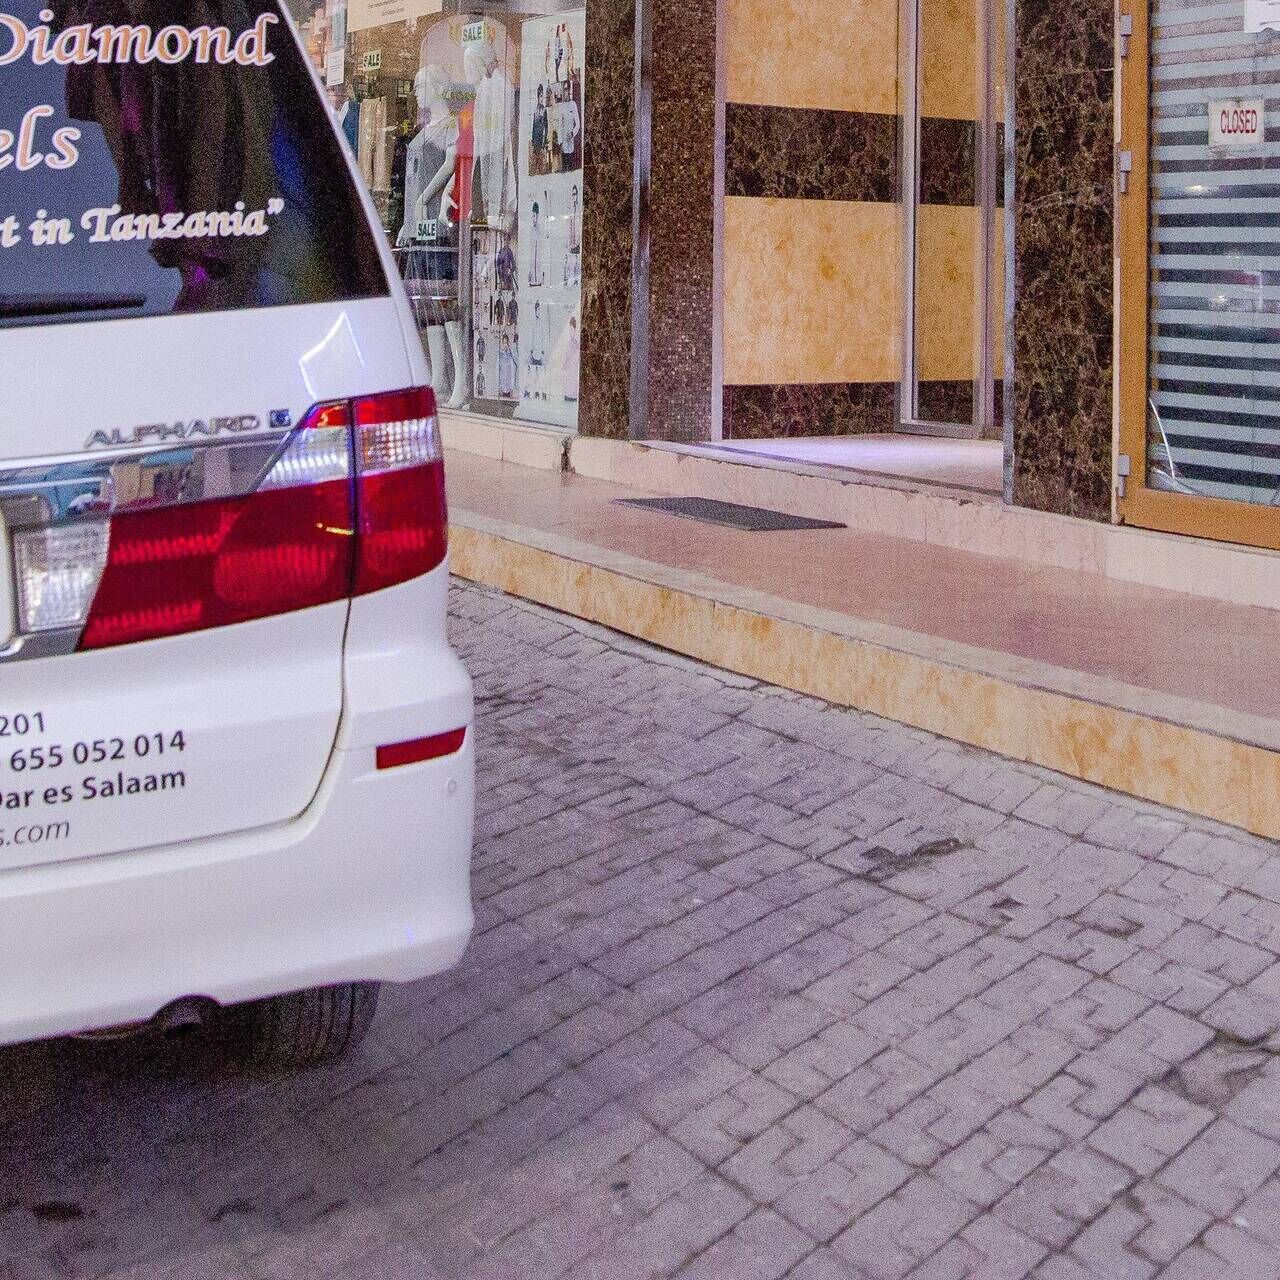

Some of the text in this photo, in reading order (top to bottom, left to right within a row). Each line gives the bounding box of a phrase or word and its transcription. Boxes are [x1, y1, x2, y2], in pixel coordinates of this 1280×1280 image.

[463, 26, 483, 42] SALE
[1219, 108, 1258, 135] CLOSED
[29, 209, 72, 246] in
[418, 223, 436, 238] SALE
[84, 415, 260, 449] ALPHARD
[10, 745, 63, 772] 655
[73, 738, 125, 765] 052
[134, 730, 187, 757] 014
[43, 784, 73, 804] es
[81, 769, 187, 801] Salaam
